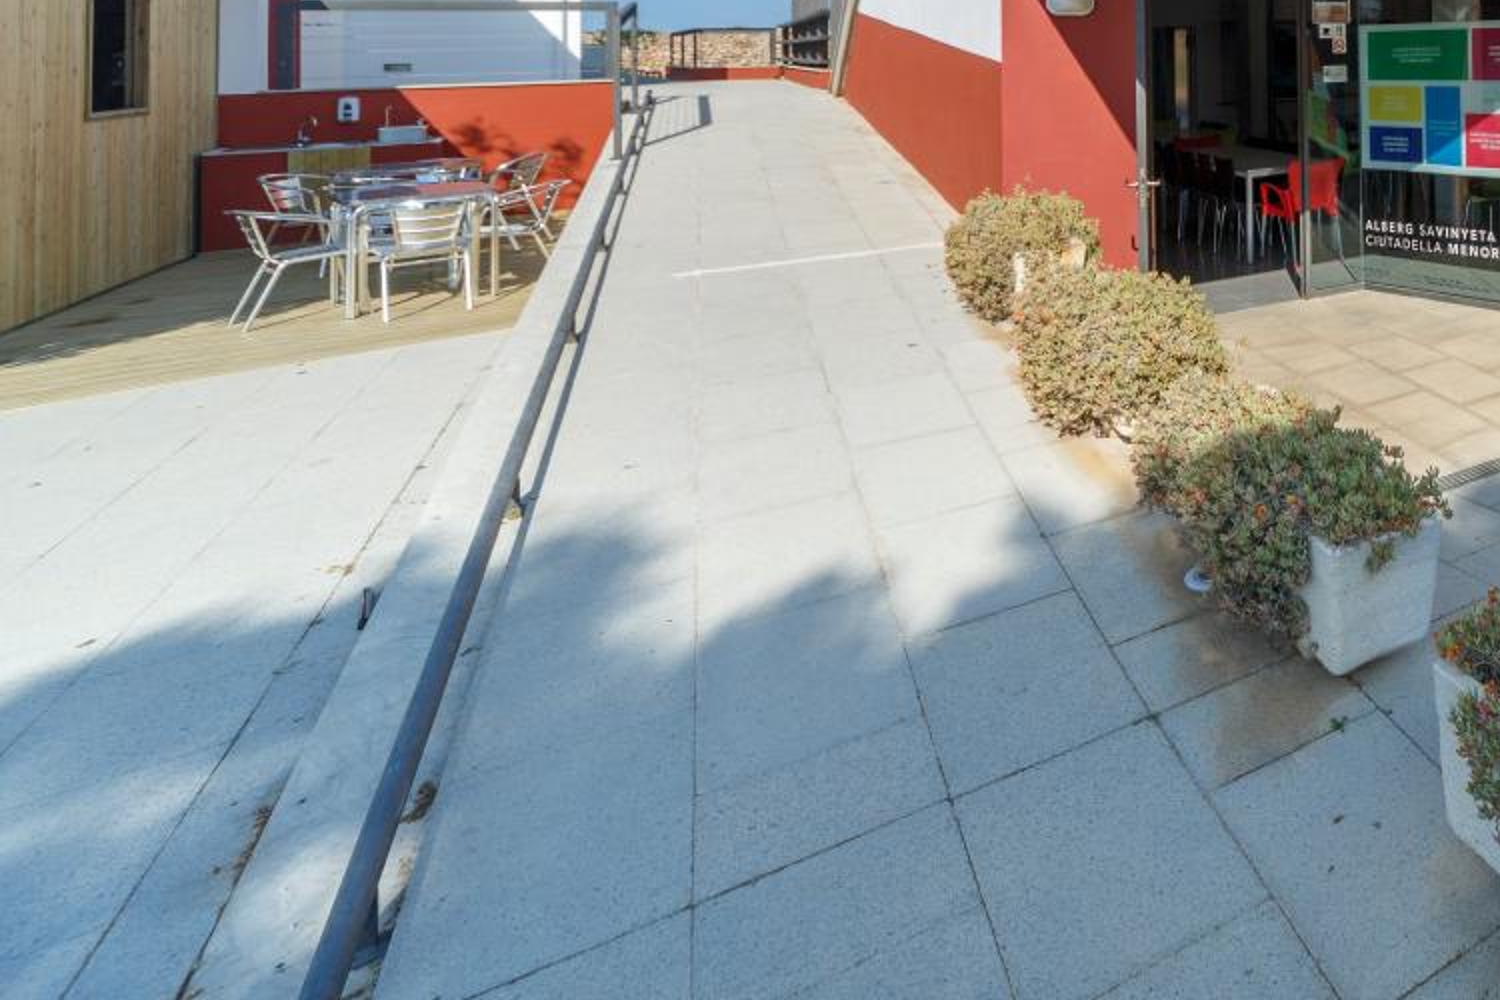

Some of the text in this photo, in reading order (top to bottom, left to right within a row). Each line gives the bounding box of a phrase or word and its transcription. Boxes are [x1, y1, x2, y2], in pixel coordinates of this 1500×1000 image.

[1365, 219, 1497, 244] ALBERG SAVINYETA
[1365, 234, 1443, 254] CIUTADELLA
